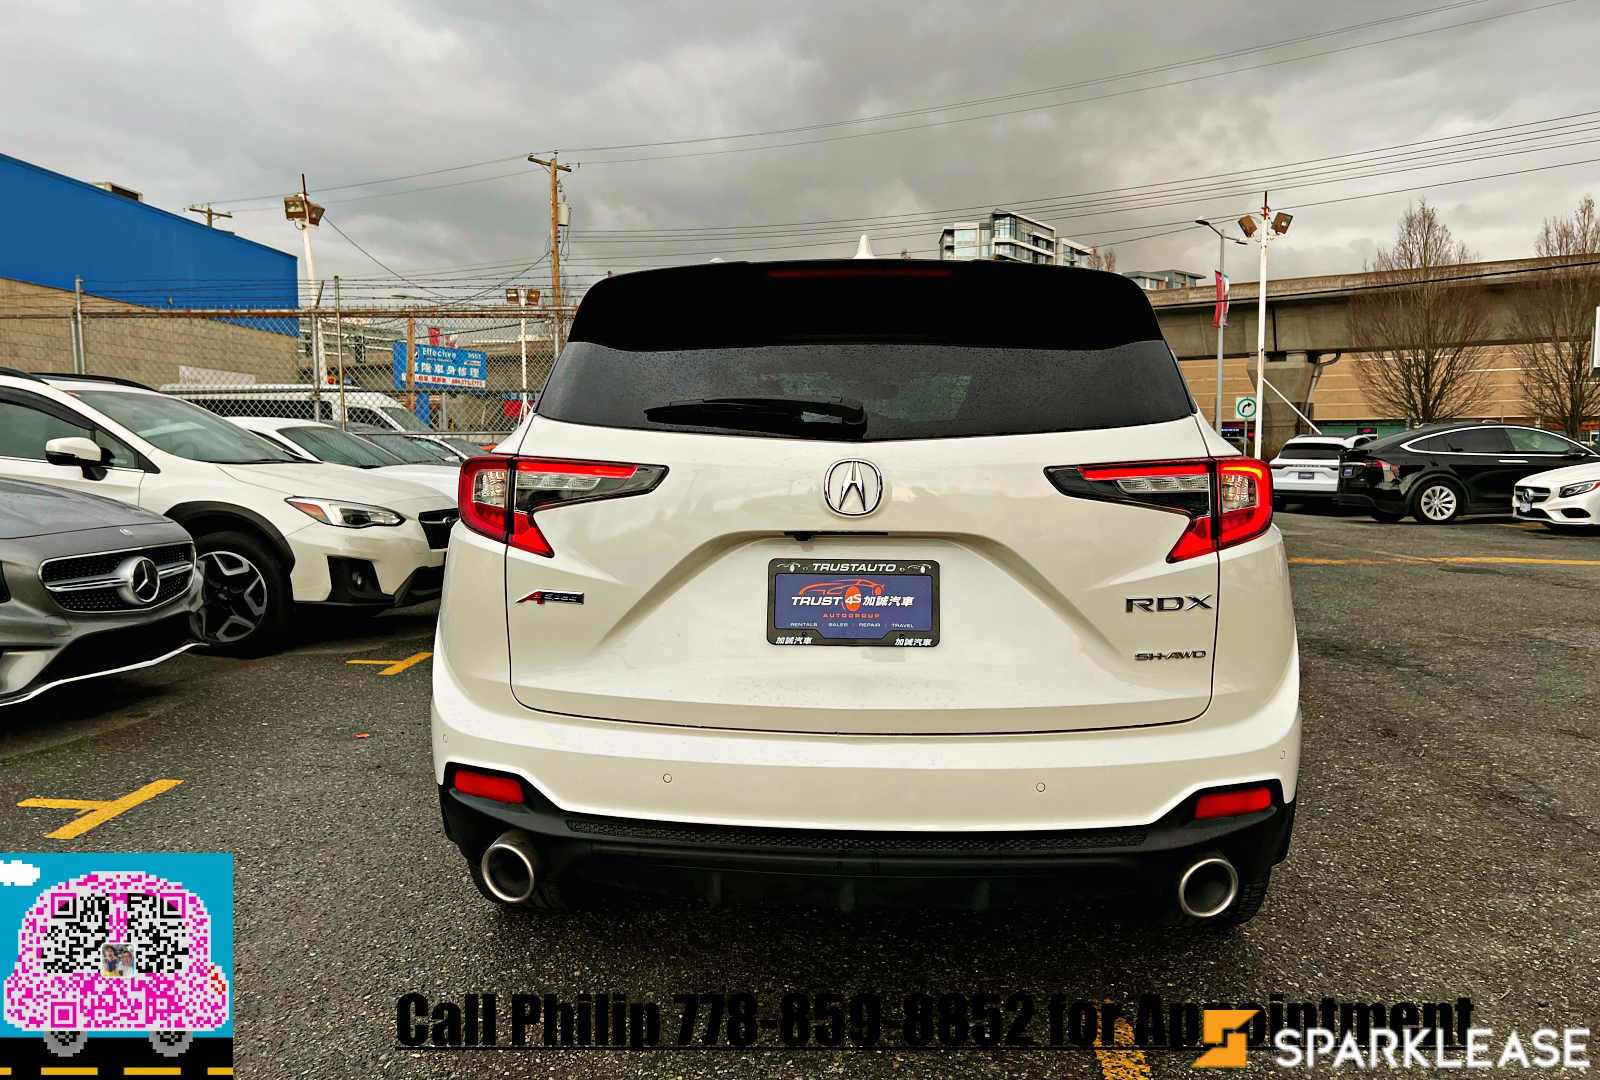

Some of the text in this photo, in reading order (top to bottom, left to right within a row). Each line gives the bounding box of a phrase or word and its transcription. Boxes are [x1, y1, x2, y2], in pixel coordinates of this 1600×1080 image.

[422, 347, 457, 358] Effective
[812, 563, 897, 572] TRUSTAUTO
[791, 596, 843, 606] TRUST
[862, 596, 915, 607] 加誠汽車
[1125, 594, 1213, 613] RDX
